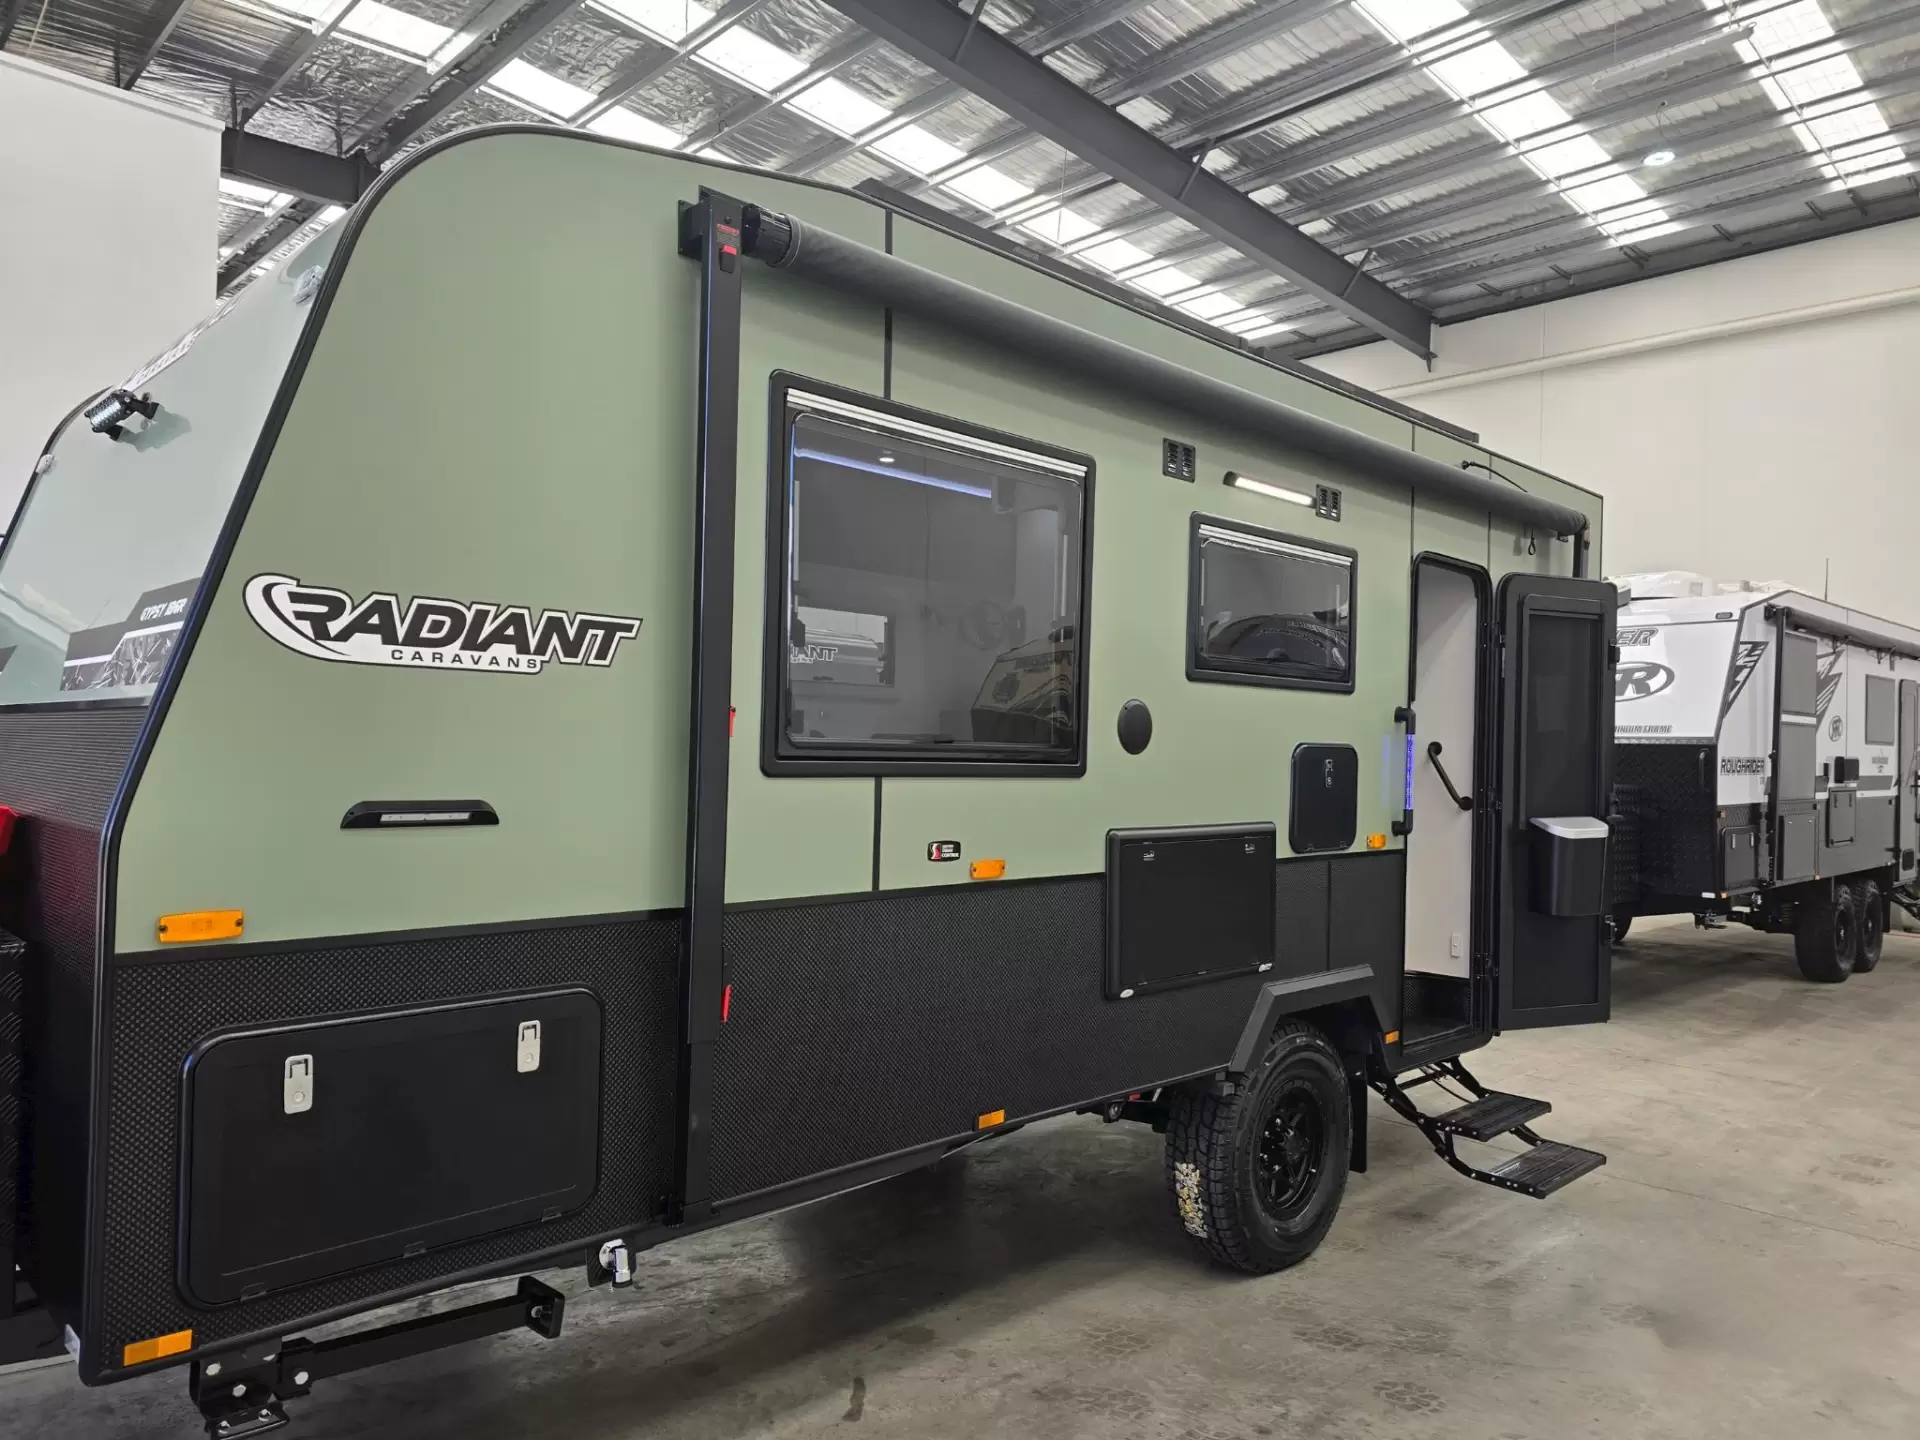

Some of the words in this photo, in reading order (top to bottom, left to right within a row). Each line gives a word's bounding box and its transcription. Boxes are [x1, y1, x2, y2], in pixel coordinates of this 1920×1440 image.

[286, 589, 640, 664] RADIANT
[1616, 628, 1659, 647] ER
[391, 648, 538, 670] CARAVANS
[1719, 757, 1766, 774] ROUGHRIDER
